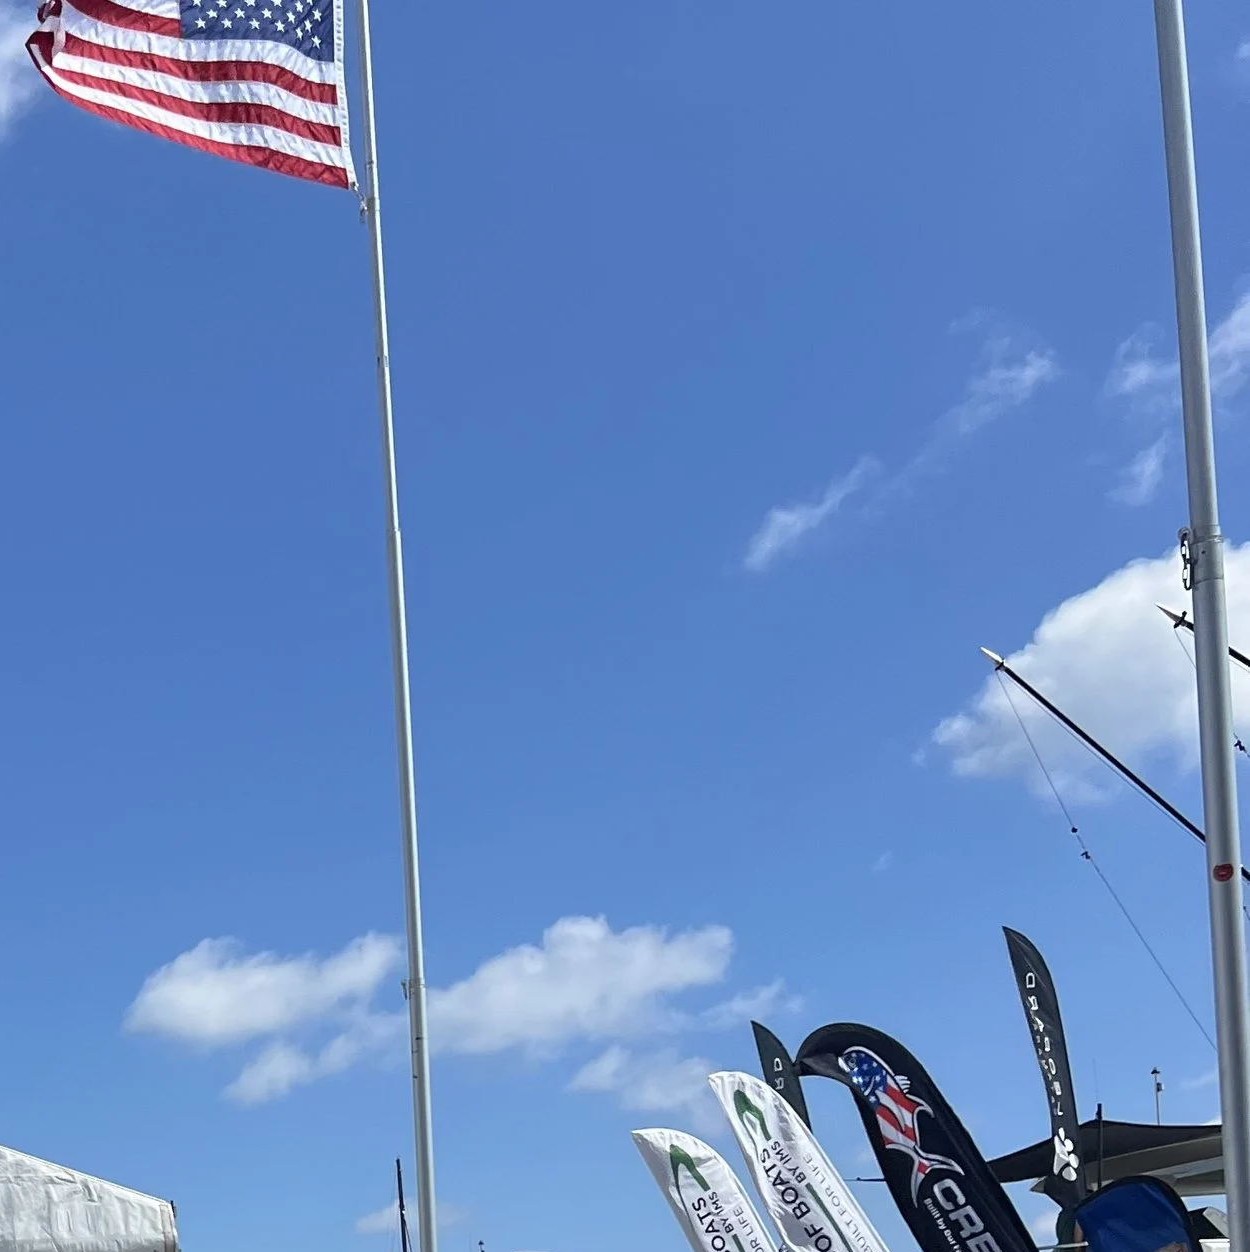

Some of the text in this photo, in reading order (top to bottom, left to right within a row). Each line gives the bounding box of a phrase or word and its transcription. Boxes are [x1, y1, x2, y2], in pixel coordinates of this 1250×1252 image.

[771, 1141, 807, 1183] BY IMS
[804, 1152, 826, 1183] LIFE
[760, 1149, 811, 1220] BOATS
[826, 1184, 846, 1216] FOR
[707, 1191, 735, 1234] BY IMS
[733, 1206, 752, 1238] LIFE
[923, 1197, 941, 1221] Built
[936, 1217, 949, 1231] by
